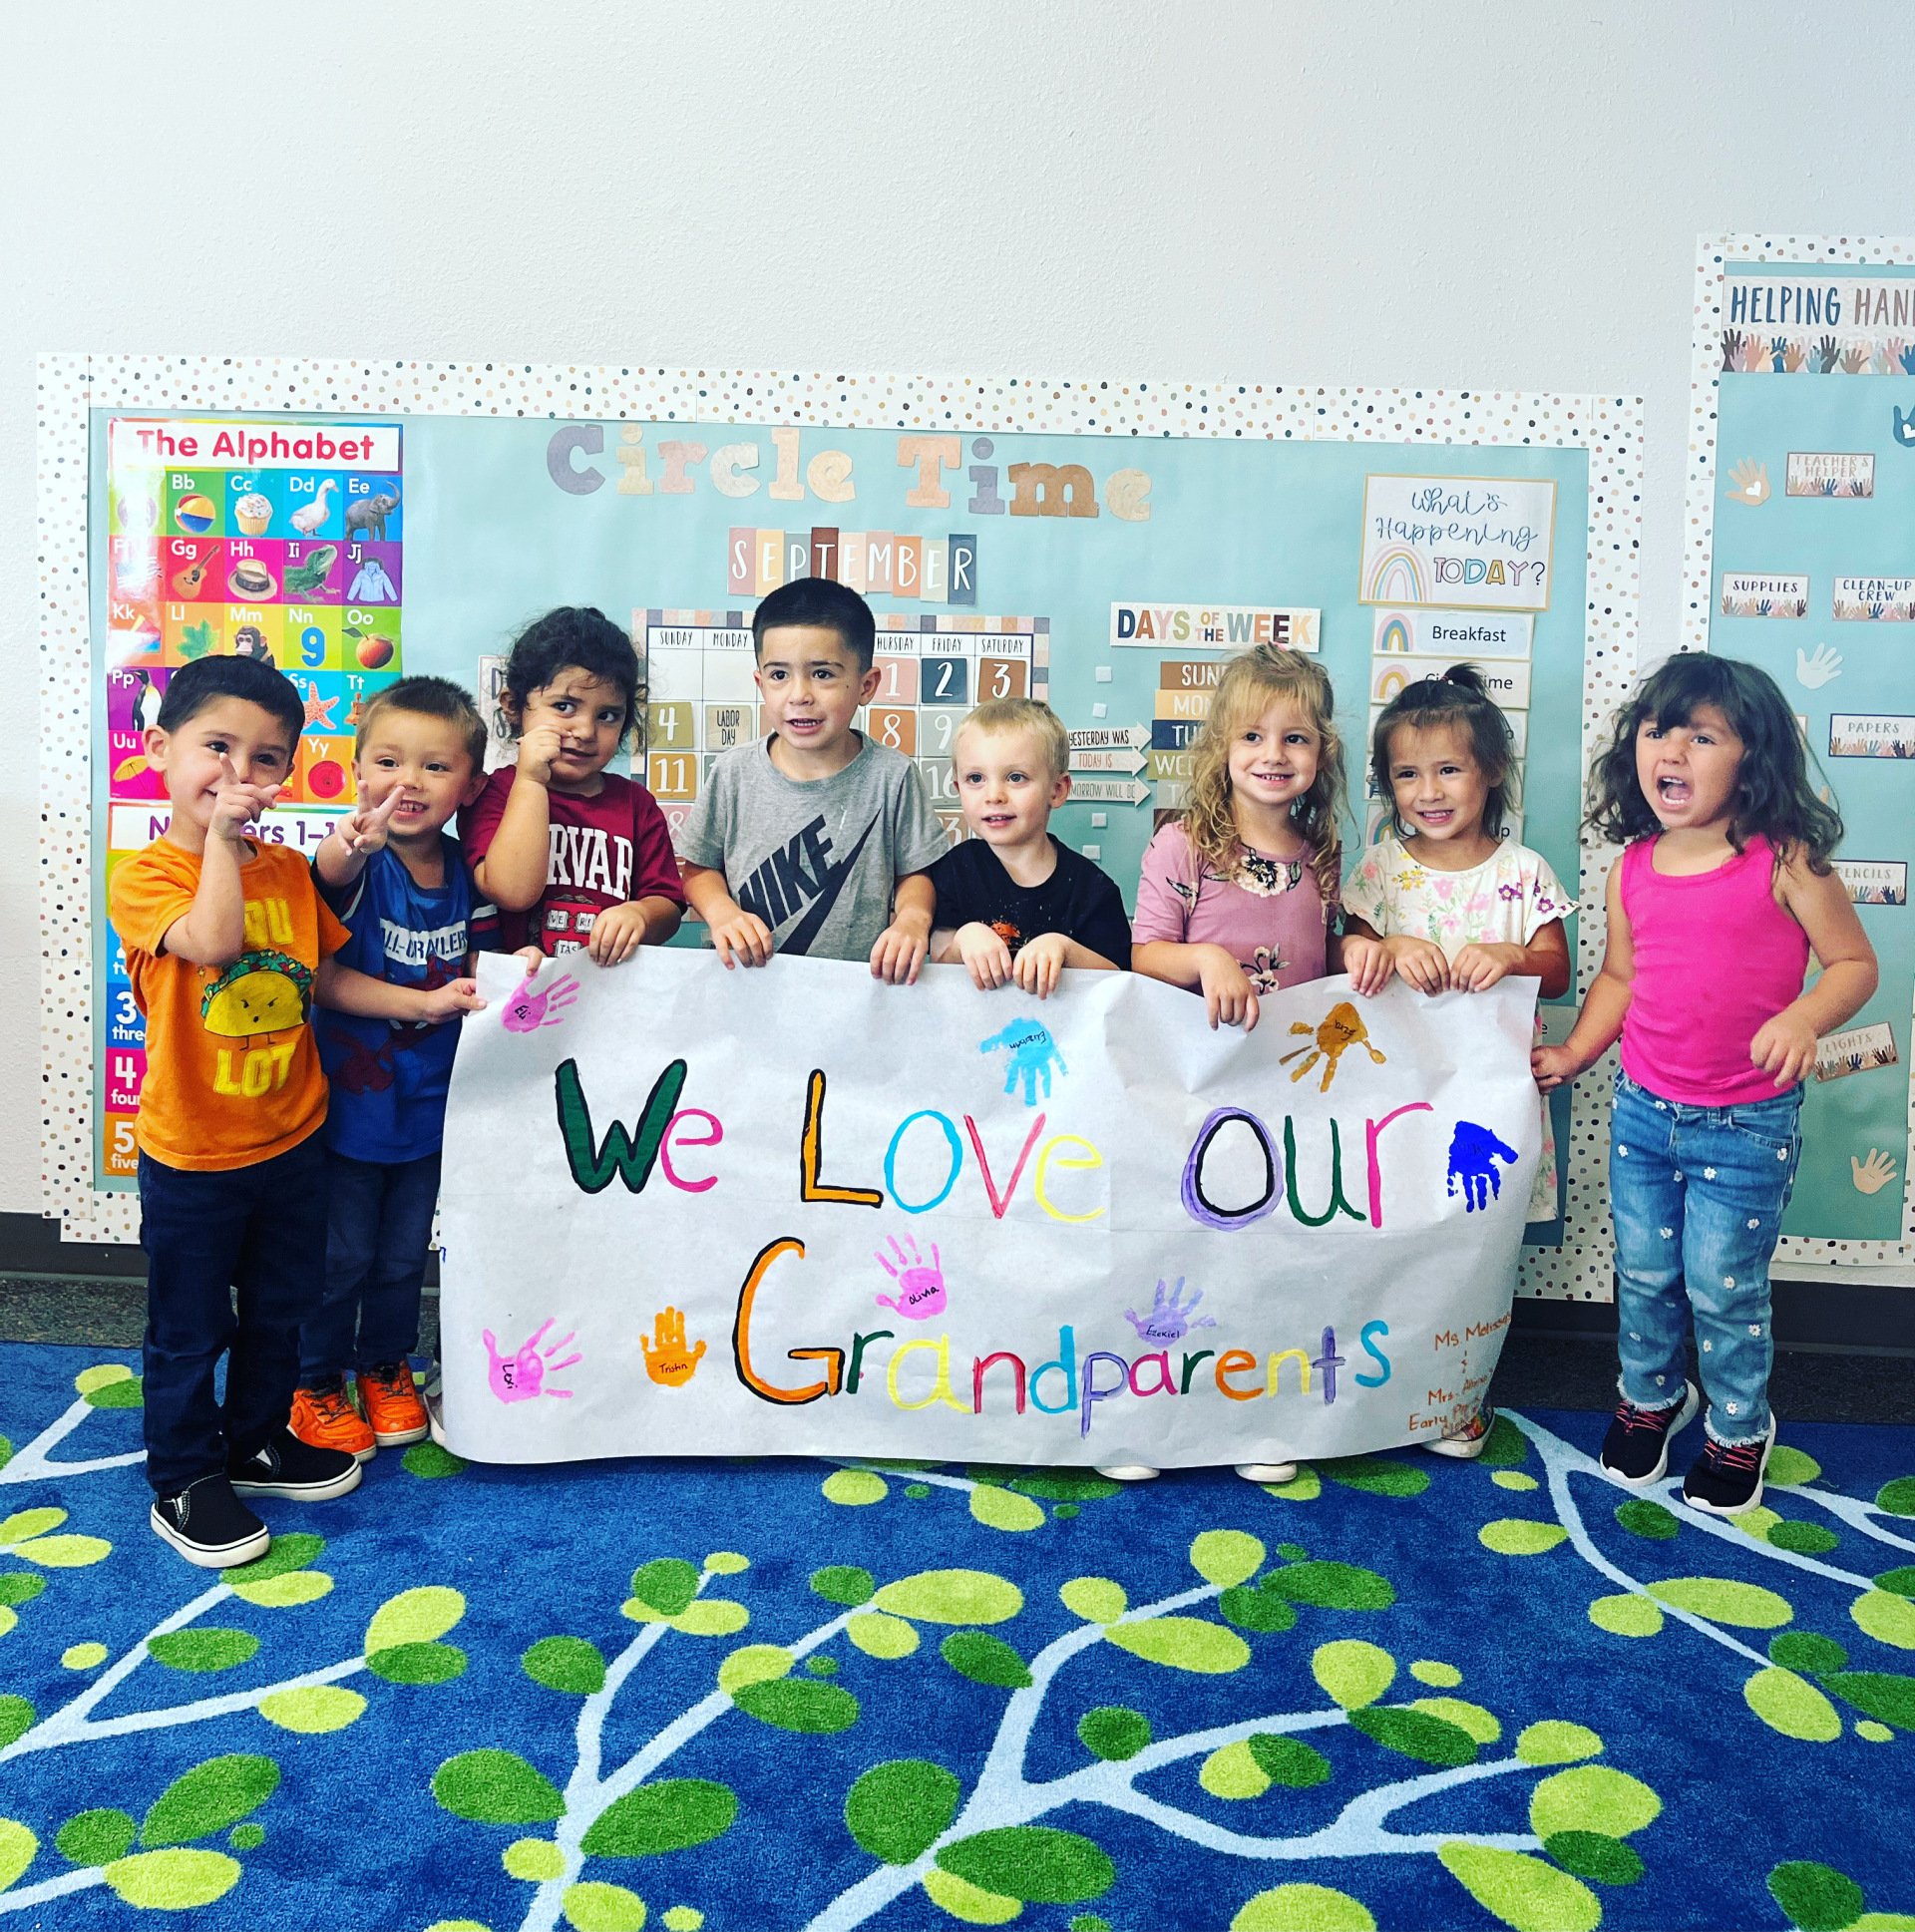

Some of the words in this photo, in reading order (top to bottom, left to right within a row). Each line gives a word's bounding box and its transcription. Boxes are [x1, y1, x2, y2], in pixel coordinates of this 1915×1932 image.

[1730, 285, 1841, 326] HELPING
[1854, 287, 1915, 326] HAN
[137, 429, 197, 457] The
[212, 430, 374, 465] Alphabet
[547, 423, 856, 503] Circle
[897, 437, 1152, 522] Time
[1794, 455, 1870, 468] TEACHER'S
[1805, 466, 1857, 478] HELPER
[172, 474, 194, 490] Bb
[230, 476, 253, 492] Cc
[289, 477, 314, 493] Dd
[348, 479, 370, 494] Ee
[1411, 487, 1508, 516] What's
[1376, 517, 1539, 552] Happening
[172, 540, 196, 559] Gg
[230, 542, 254, 558] Hh
[288, 542, 300, 559] Ii
[347, 545, 362, 564] Jj
[731, 540, 973, 590] SEPTEMBER
[1434, 557, 1546, 586] TODAY?
[1732, 580, 1798, 593] SUPPLIES
[1843, 579, 1912, 591] CLEAN-UP
[1858, 589, 1896, 601] CREW
[113, 602, 136, 619] Kk
[230, 607, 262, 623] Mm
[289, 608, 313, 623] Nn
[347, 608, 374, 625] Oo
[1200, 611, 1220, 625] OF
[1117, 608, 1191, 640] DAYS
[1227, 612, 1313, 644] WEEK
[1195, 627, 1224, 641] THE
[1432, 624, 1507, 642] Breakfast
[659, 630, 693, 645] SUNDAY
[712, 632, 748, 647] MONDAY
[876, 638, 915, 651] HURSDAY
[933, 638, 962, 651] FRIDAY
[981, 638, 1024, 653] SATURDAY
[112, 669, 135, 688] Pp
[347, 674, 365, 690] Tt
[885, 661, 901, 697] 1
[935, 661, 954, 697] 2
[991, 663, 1011, 698] 3
[1181, 663, 1227, 687] SUN
[1484, 675, 1513, 691] ime
[658, 706, 678, 741] 4
[882, 713, 902, 749] 8
[935, 714, 953, 749] 9
[716, 709, 740, 727] LABOR
[1848, 721, 1900, 734] PAPERS
[113, 733, 137, 750] Uu
[307, 738, 330, 757] Yy
[721, 728, 736, 745] DAY
[1068, 730, 1109, 746] YESTERDAY
[1112, 729, 1130, 744] WAS
[1078, 753, 1102, 769] TODAY
[1105, 753, 1113, 768] IS
[655, 757, 689, 793] 11
[1070, 782, 1102, 798] MORROW
[1106, 783, 1123, 798] WILL
[150, 815, 284, 844] Ners
[547, 824, 634, 901] RVAR
[738, 814, 842, 932] NIKE
[1836, 866, 1892, 880] PENCILS
[244, 898, 295, 948] OU
[115, 990, 137, 1024] 3
[112, 1024, 146, 1041] thre
[1825, 1031, 1873, 1053] LIGHTS
[115, 1056, 137, 1089] 4
[212, 1042, 298, 1098] LOT
[114, 1120, 135, 1154] 5
[555, 1057, 724, 1195] We
[111, 1153, 139, 1170] five
[732, 1236, 1393, 1440] Grandparents
[1409, 1412, 1449, 1431] Early
